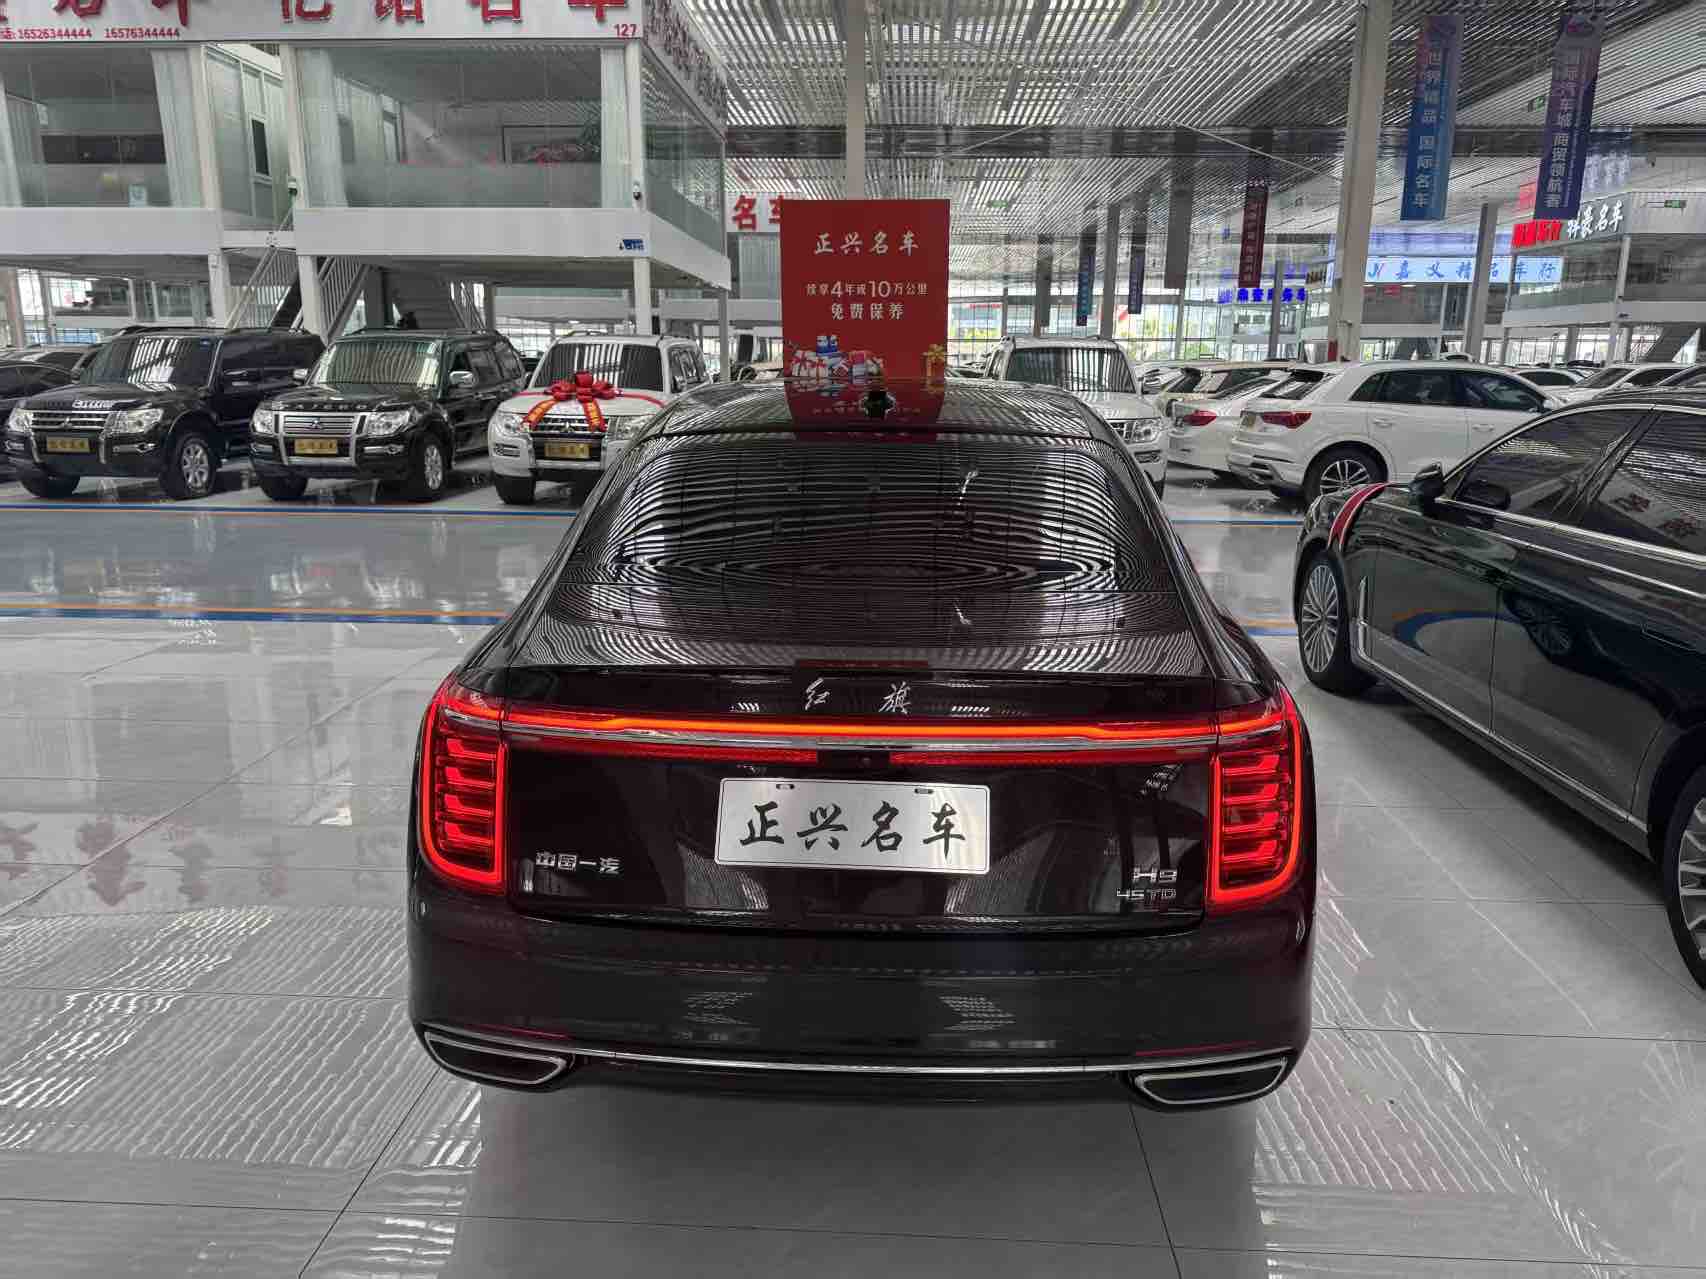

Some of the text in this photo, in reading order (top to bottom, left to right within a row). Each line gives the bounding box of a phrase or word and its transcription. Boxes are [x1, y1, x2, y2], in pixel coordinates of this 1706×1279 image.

[615, 24, 637, 36] 127
[814, 230, 920, 256] 正兴名车
[831, 302, 904, 320] 免费保养
[804, 677, 911, 714] 红旗
[739, 800, 966, 858] 正兴名车
[535, 851, 620, 874] 中国一汽
[1133, 866, 1178, 883] H9
